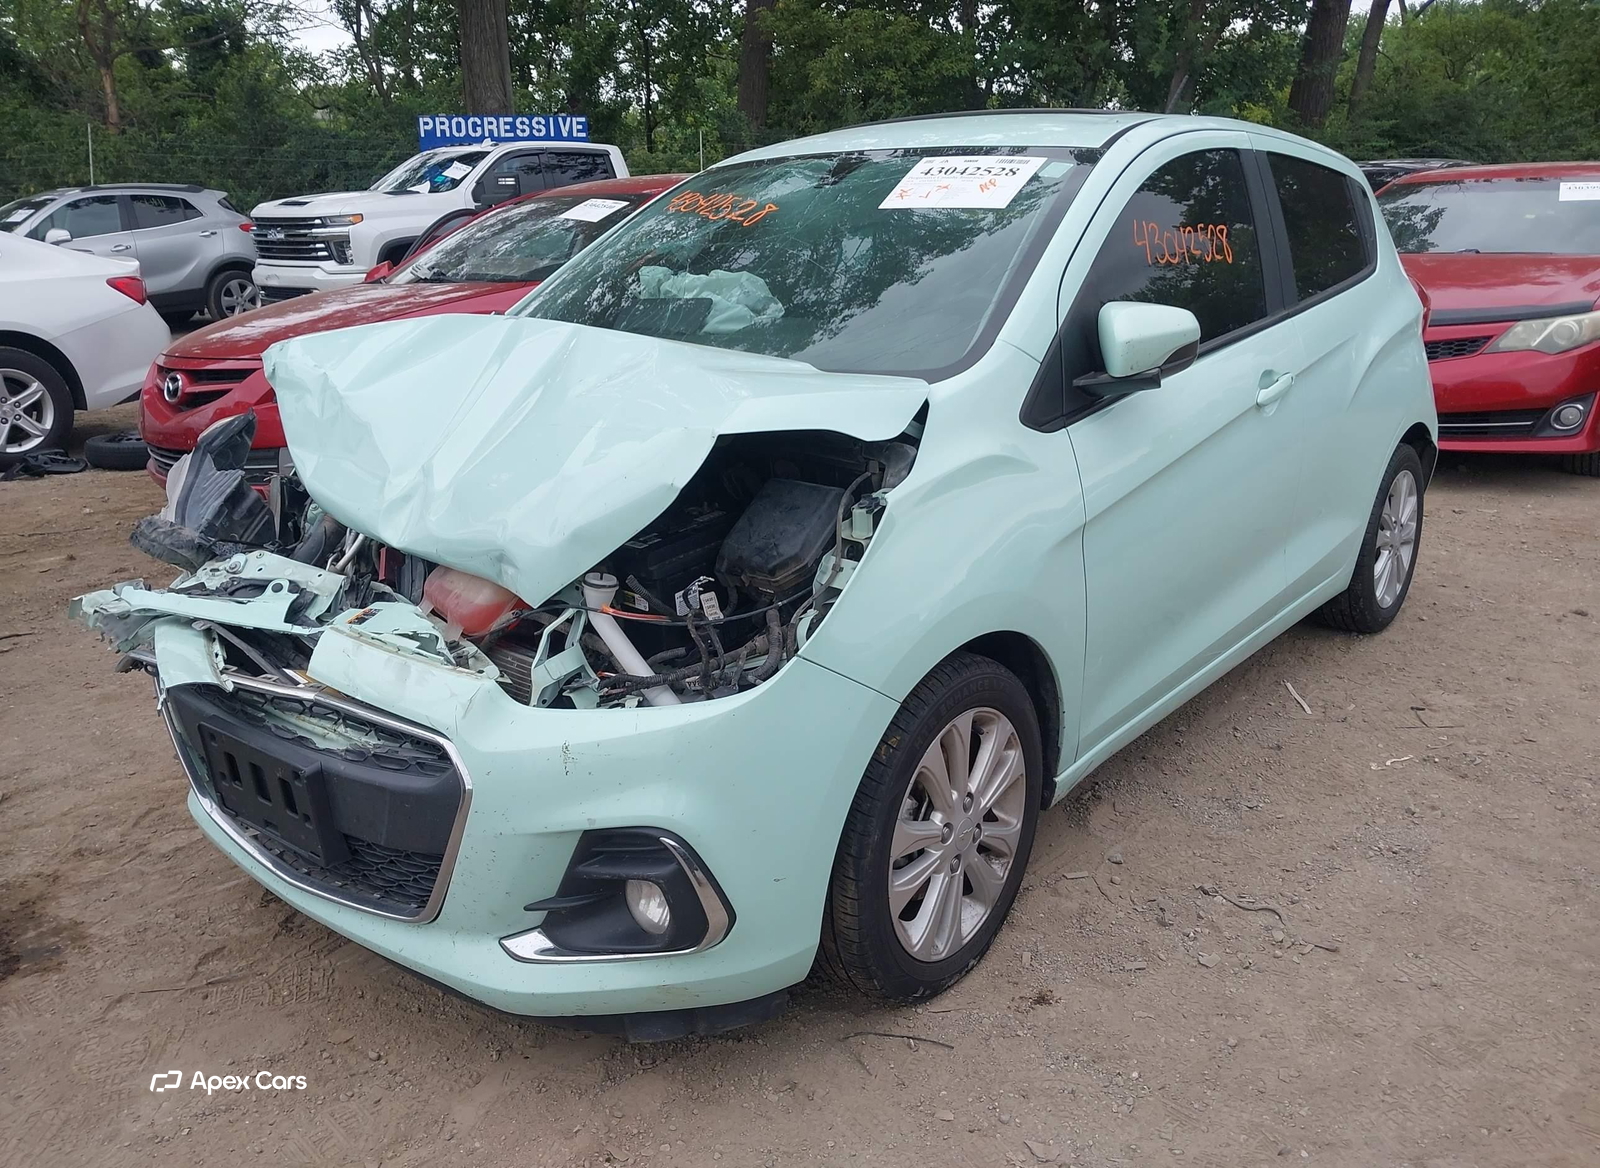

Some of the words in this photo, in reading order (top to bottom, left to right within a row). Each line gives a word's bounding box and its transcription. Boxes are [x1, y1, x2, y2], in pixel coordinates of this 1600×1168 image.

[419, 116, 588, 138] PROGRESSIVE
[920, 166, 1021, 177] 43042528
[1133, 219, 1233, 265] 43042528
